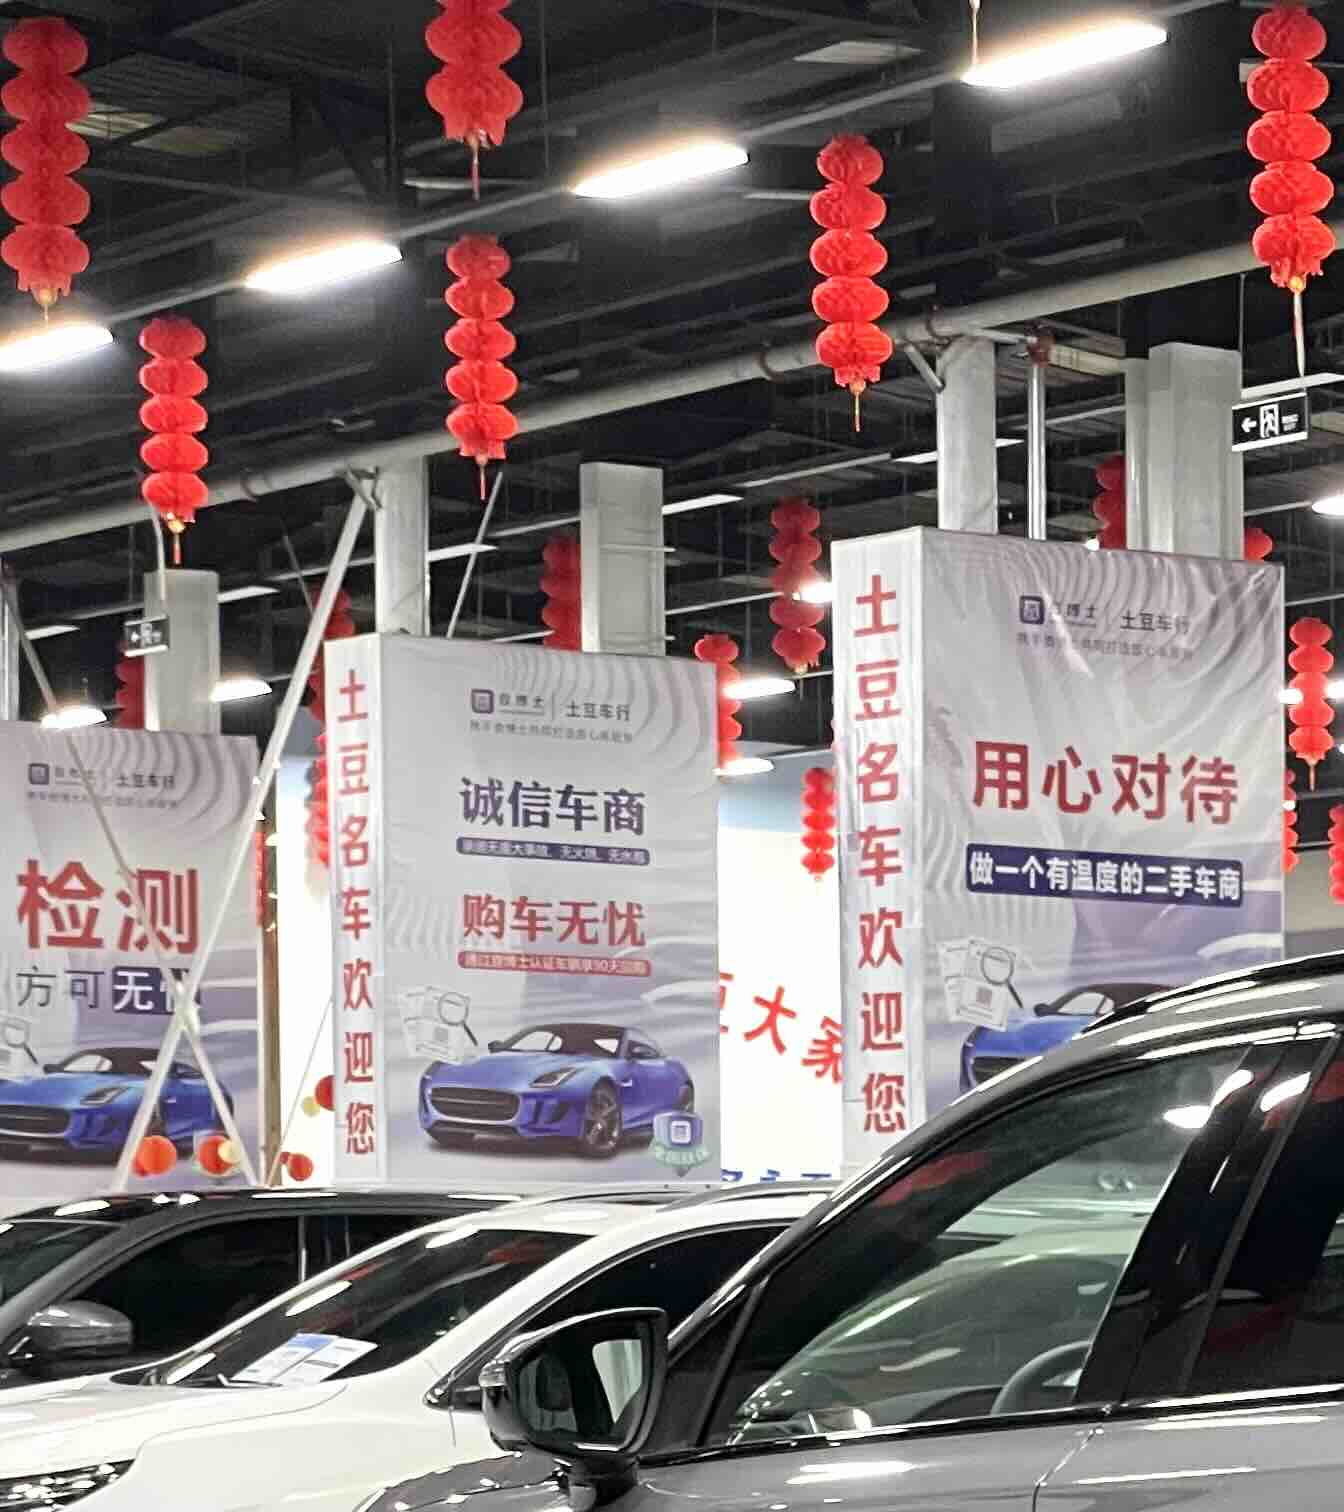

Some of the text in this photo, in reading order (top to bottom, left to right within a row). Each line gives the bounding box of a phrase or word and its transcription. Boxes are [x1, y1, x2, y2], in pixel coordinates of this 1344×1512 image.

[1120, 610, 1190, 635] 土豆车行
[459, 776, 645, 836] 诚信车商
[973, 741, 1238, 825] 用心对待
[854, 574, 905, 1133] 土豆名车欢迎您
[970, 851, 1241, 900] 做一个有温度的二手车商
[17, 858, 199, 954] 检测
[337, 669, 376, 1156] 土豆名车欢迎您
[463, 894, 645, 946] 购车无忧
[16, 964, 190, 1015] 方可无
